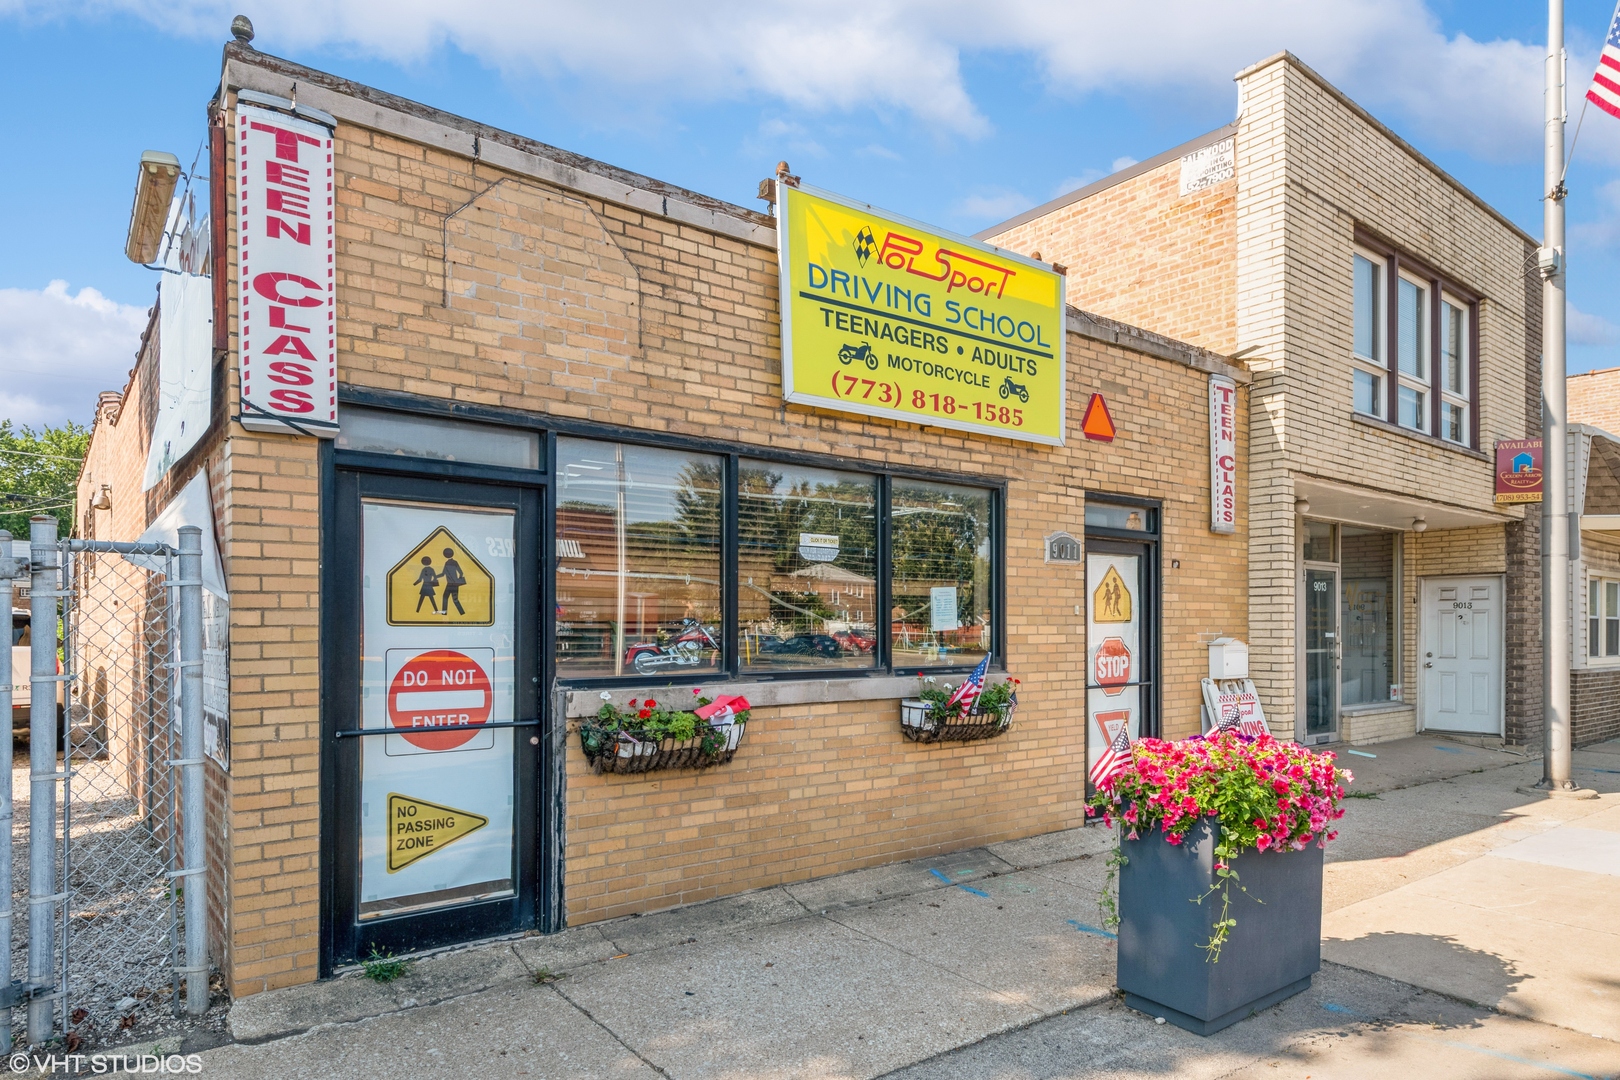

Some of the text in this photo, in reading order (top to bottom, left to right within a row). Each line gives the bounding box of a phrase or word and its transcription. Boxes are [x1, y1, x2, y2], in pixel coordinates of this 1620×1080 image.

[250, 121, 325, 413] TEEN CLASS
[809, 262, 1051, 348] DRIVING SCHOOL
[820, 307, 1037, 376] TEENAGERS ADULTS
[887, 354, 990, 388] MOTORCYCLE
[831, 370, 1023, 426] (773) 818-1585
[1216, 385, 1235, 523] TEEN CLASS
[1498, 441, 1543, 449] AVAILABL
[1052, 542, 1077, 560] 9011
[1313, 581, 1327, 592] 9013
[1098, 655, 1129, 679] STOP
[403, 669, 476, 687] DO NOT
[412, 713, 469, 727] ENTER
[1108, 723, 1120, 732] YIELD
[397, 805, 417, 818] NO
[397, 817, 455, 834] PASSING
[396, 835, 434, 851] ZONE
